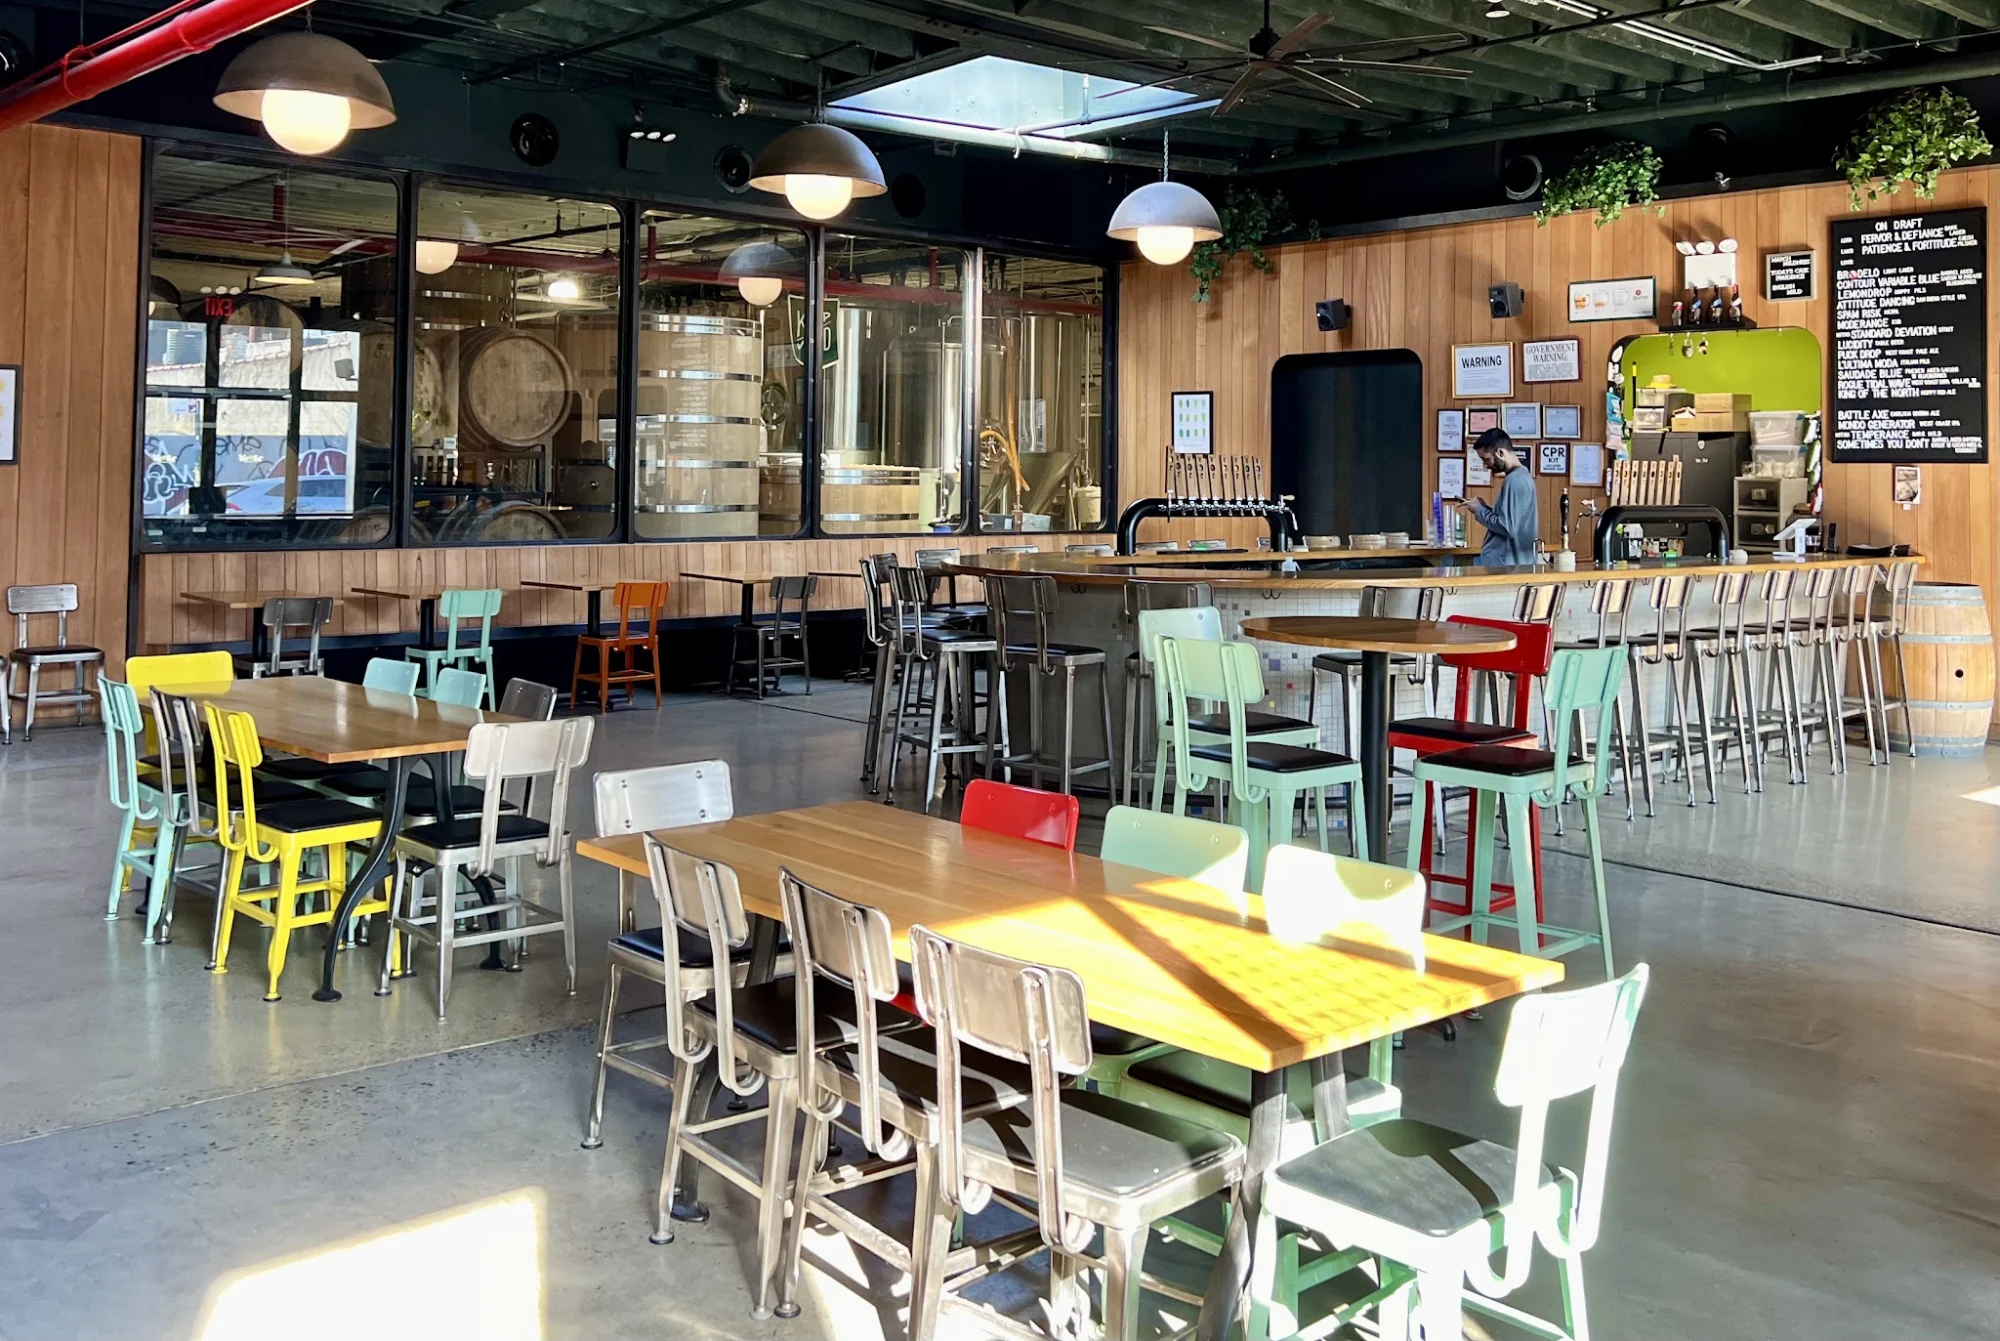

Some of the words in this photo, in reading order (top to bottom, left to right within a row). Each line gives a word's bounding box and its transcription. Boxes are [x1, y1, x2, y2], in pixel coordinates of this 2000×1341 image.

[1876, 221, 1887, 232] ON
[1894, 218, 1923, 230] DRAFT
[1861, 232, 1893, 244] FERVOR
[1894, 231, 1901, 241] &
[1902, 227, 1944, 240] DEFIANCE
[1862, 242, 1903, 255] PATIENCE
[1904, 242, 1911, 251] &
[1912, 238, 1957, 251] FORTITUDE
[1836, 278, 1876, 290] CONTOUR
[1878, 275, 1917, 287] VARIABLE
[1918, 273, 1940, 285] BLUE
[1838, 287, 1893, 300] LEMONDROP
[1836, 298, 1877, 310] ATTITUDE
[1880, 295, 1916, 308] DANCING
[1837, 309, 1859, 320] SPAM
[1861, 308, 1882, 319] RISK
[1837, 318, 1889, 330] MODERANCE
[1850, 328, 1893, 340] STANDARD
[1894, 325, 1937, 337] DEVIATION
[1526, 342, 1577, 355] GOVERNMENT
[1838, 339, 1874, 350] LUCIDITY
[1533, 352, 1568, 364] WARNING:
[1838, 350, 1858, 360] PUCK
[1859, 348, 1882, 359] DROP
[1461, 355, 1502, 369] WARNING
[1838, 360, 1874, 370] L'ULTIMA
[1874, 358, 1899, 369] MODA
[1838, 369, 1877, 380] SAUDADE
[1879, 367, 1904, 379] BLUE
[1838, 380, 1864, 390] ROGUE
[1864, 379, 1888, 389] TIDAL
[1887, 378, 1911, 389] WAVE
[1838, 389, 1856, 399] KING
[1857, 389, 1868, 399] OF
[1872, 388, 1888, 399] THE
[1890, 387, 1920, 398] NORTH
[1838, 410, 1870, 420] BATTLE
[1871, 410, 1890, 420] AXE
[1838, 420, 1866, 430] MONDO
[1867, 419, 1916, 430] GENERATOR
[1850, 430, 1910, 440] TEMPERANCE
[1836, 438, 1884, 450] SOMETIMES
[1886, 438, 1903, 449] YOU
[1904, 438, 1931, 449] DON'T
[1542, 447, 1565, 457] CPR
